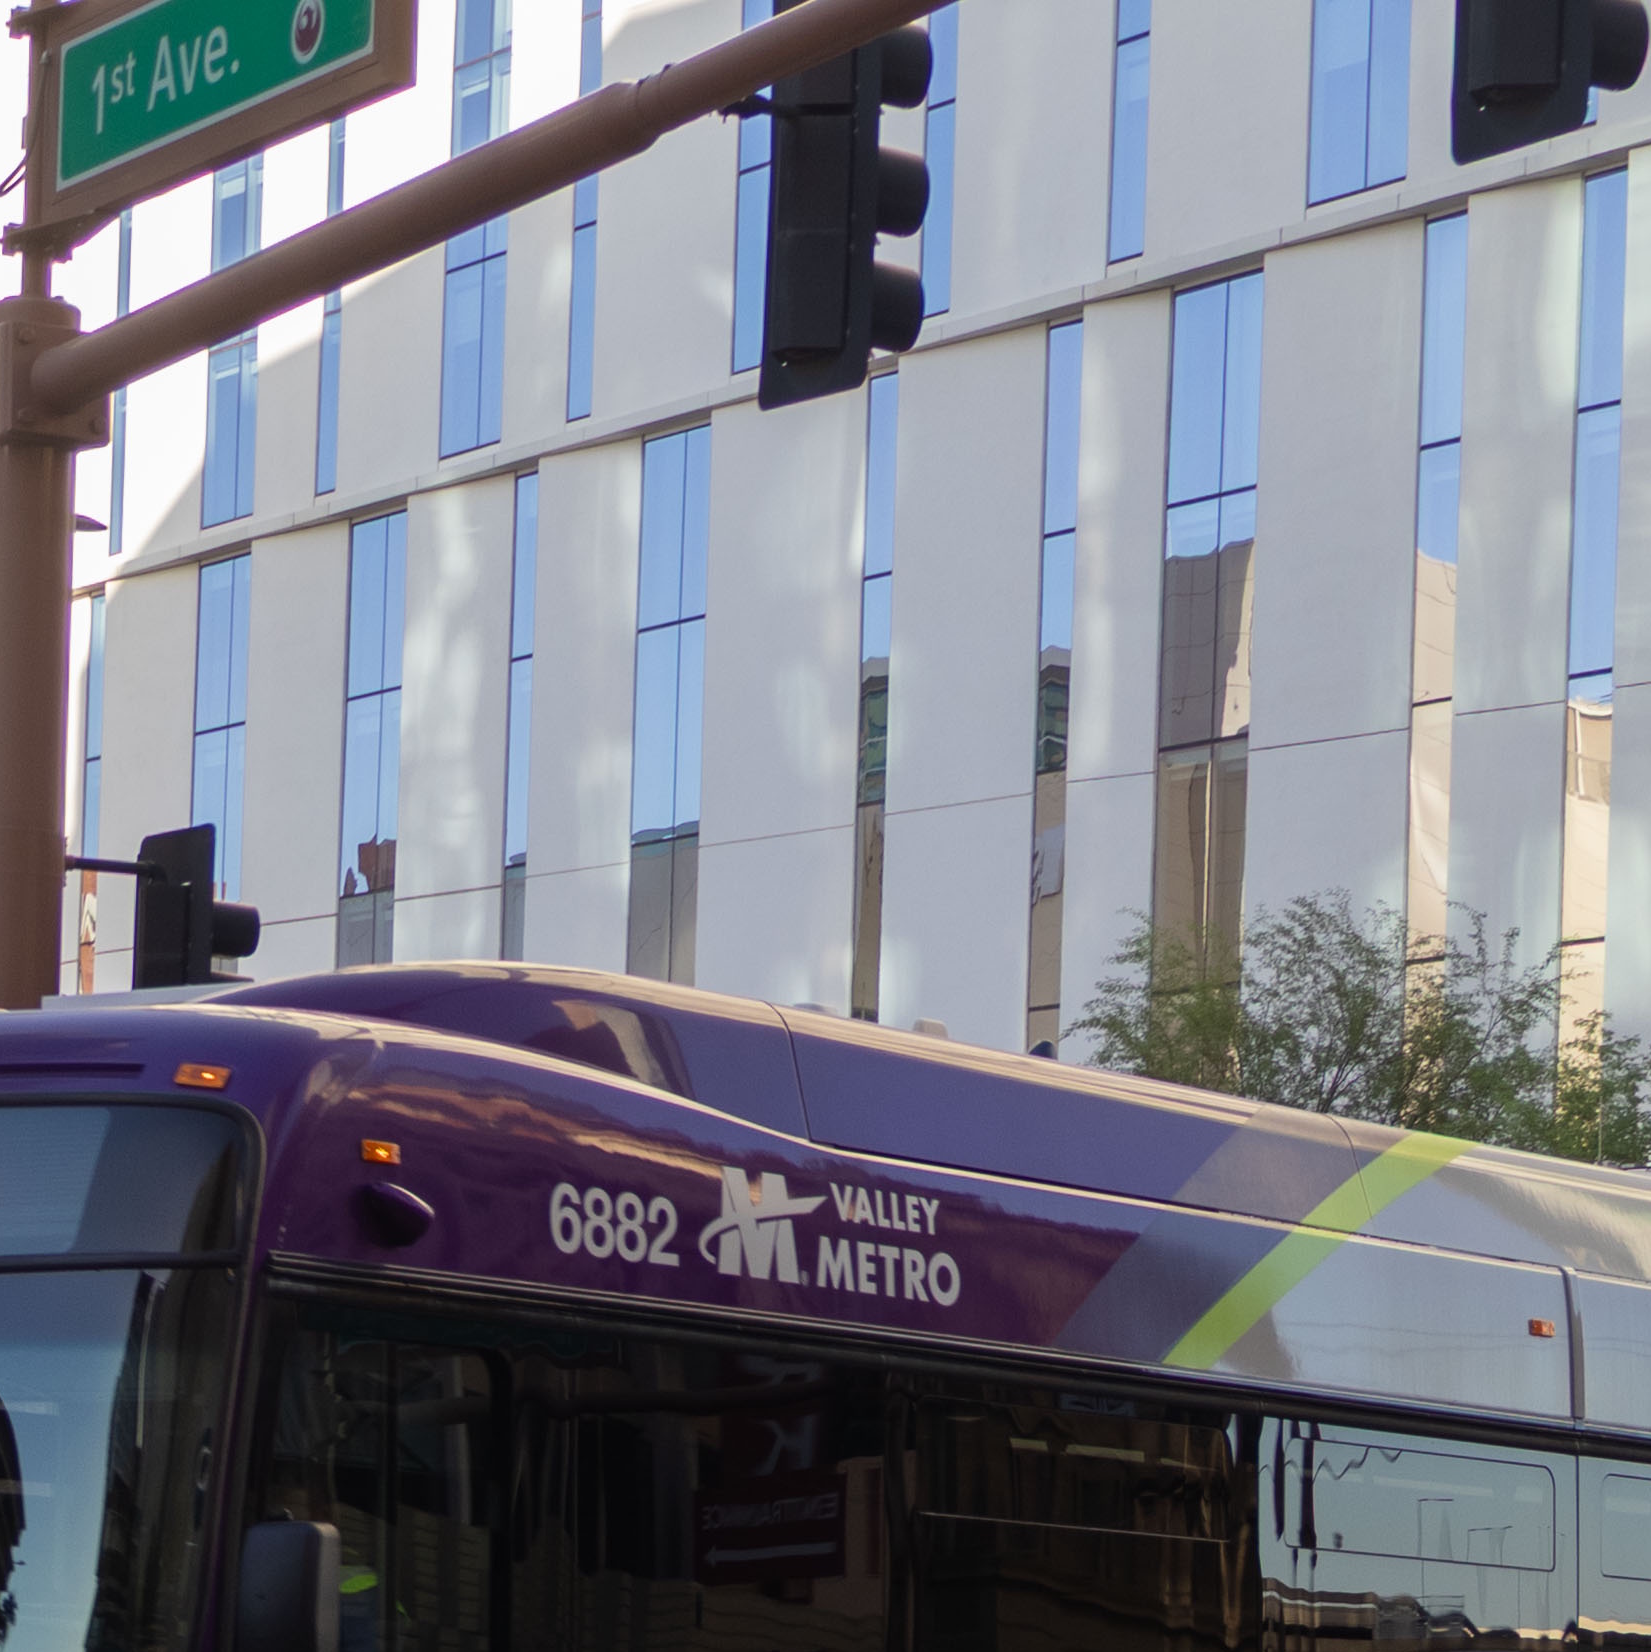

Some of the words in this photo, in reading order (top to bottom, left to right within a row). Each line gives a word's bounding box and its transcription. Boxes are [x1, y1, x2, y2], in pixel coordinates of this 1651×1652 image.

[91, 50, 137, 135] 1st
[147, 26, 240, 112] Ave.
[550, 1182, 680, 1267] 6882
[829, 1181, 939, 1236] VALLEY
[816, 1235, 960, 1306] METRO
